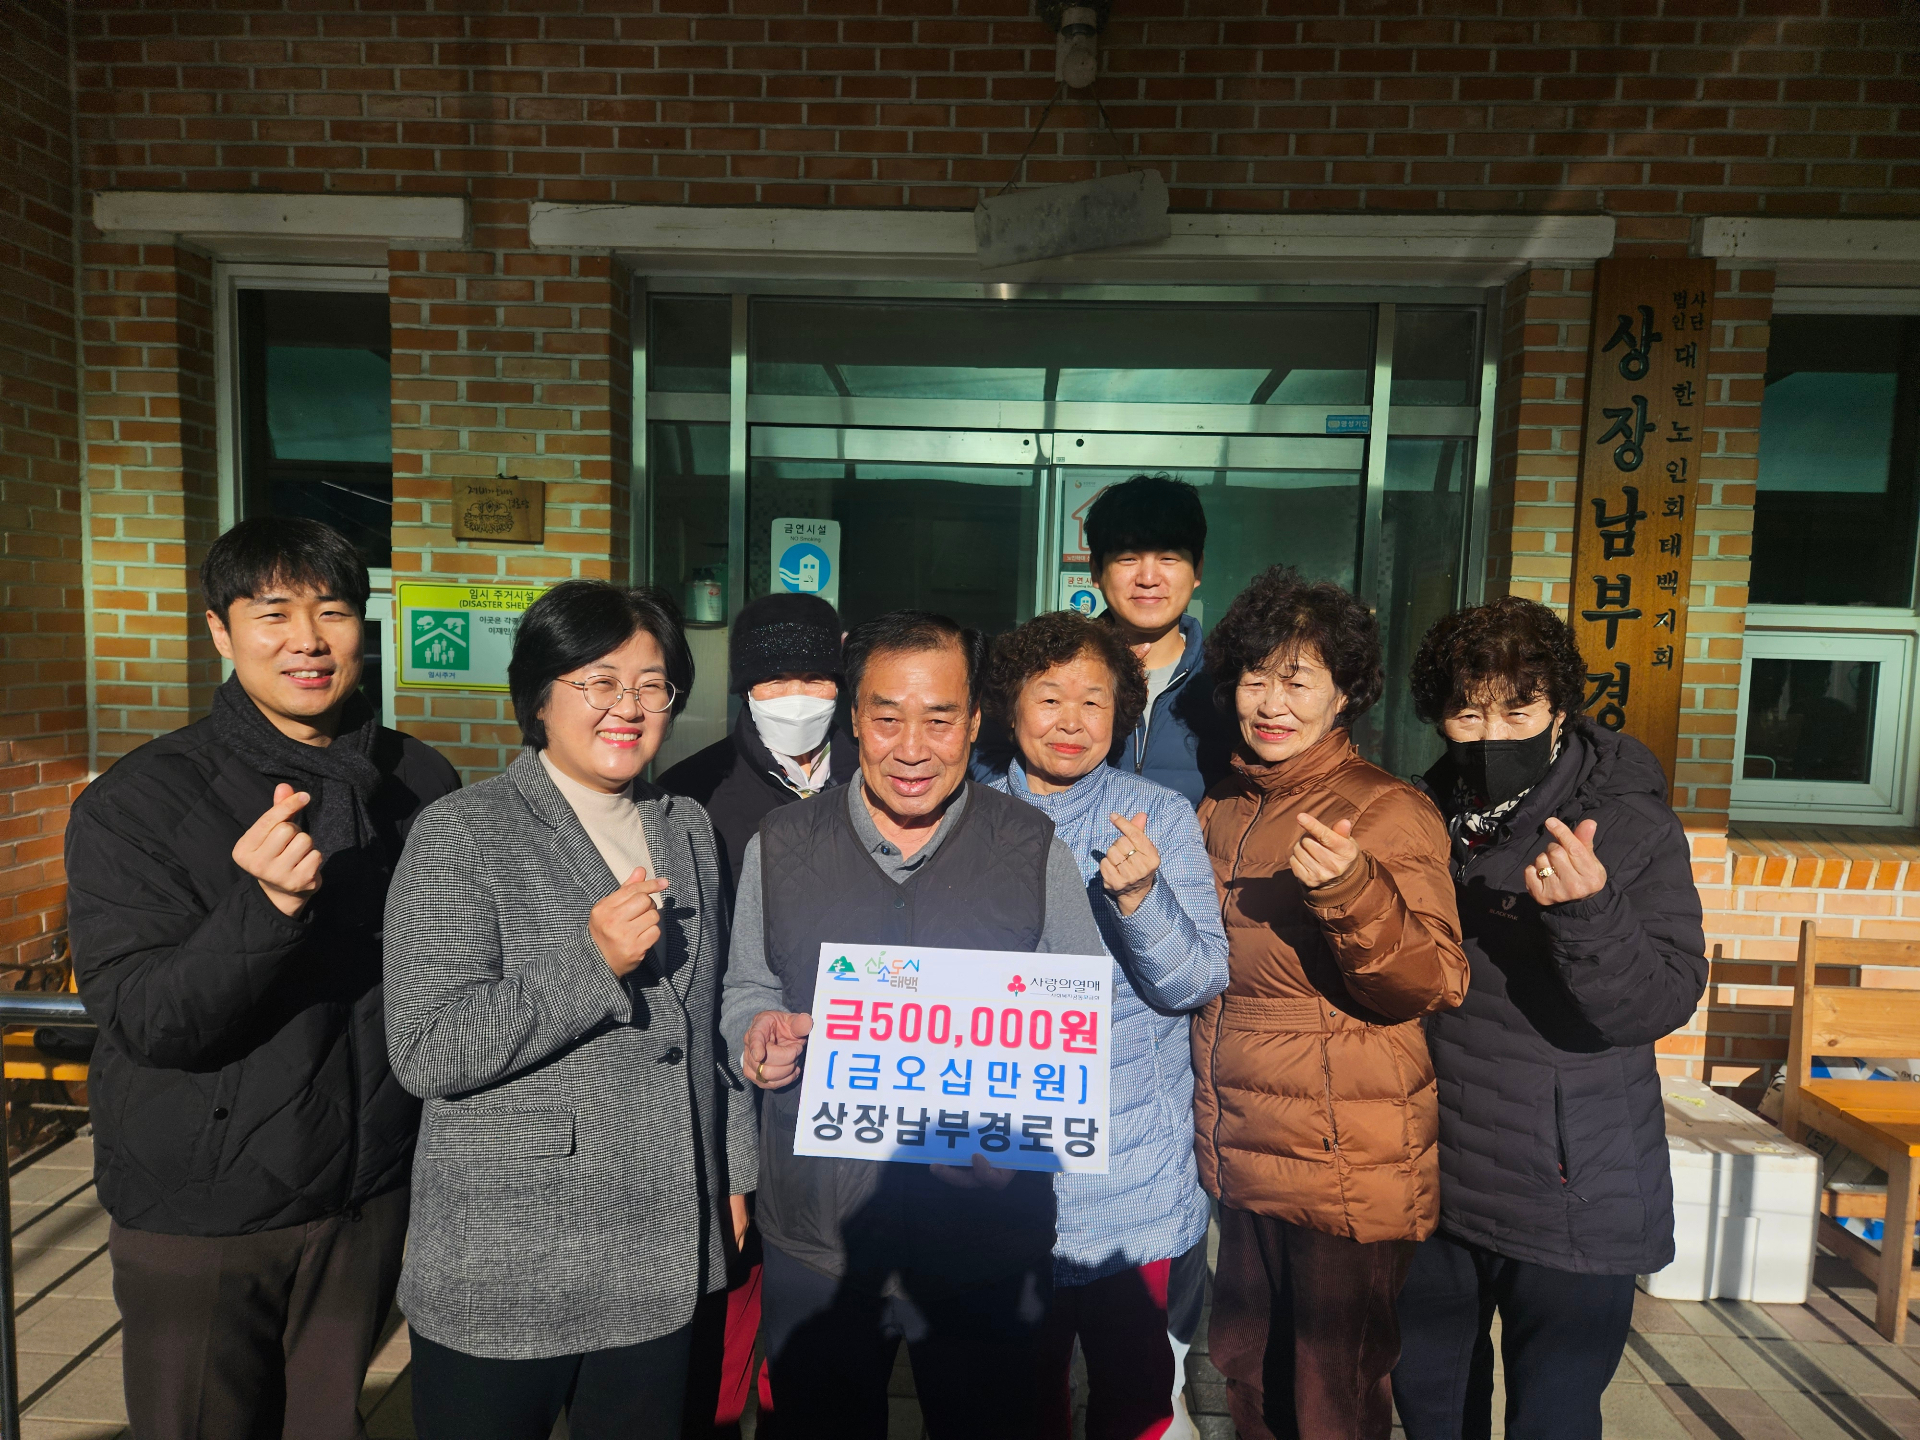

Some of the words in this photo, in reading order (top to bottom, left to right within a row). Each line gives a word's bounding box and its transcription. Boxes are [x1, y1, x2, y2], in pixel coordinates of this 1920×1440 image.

[784, 523, 827, 535] 금연시설
[469, 588, 490, 600] 임시
[493, 590, 535, 602] 주거시설
[459, 600, 503, 609] (DISASTER
[479, 616, 502, 625] 이곳은
[488, 626, 511, 635] 이재민
[428, 671, 456, 679] 임시주거
[890, 975, 918, 992] 태백
[1030, 977, 1100, 993] 사랑의열매
[825, 998, 1098, 1055] 금500,000원
[811, 1101, 1099, 1158] 상장남부경로당
